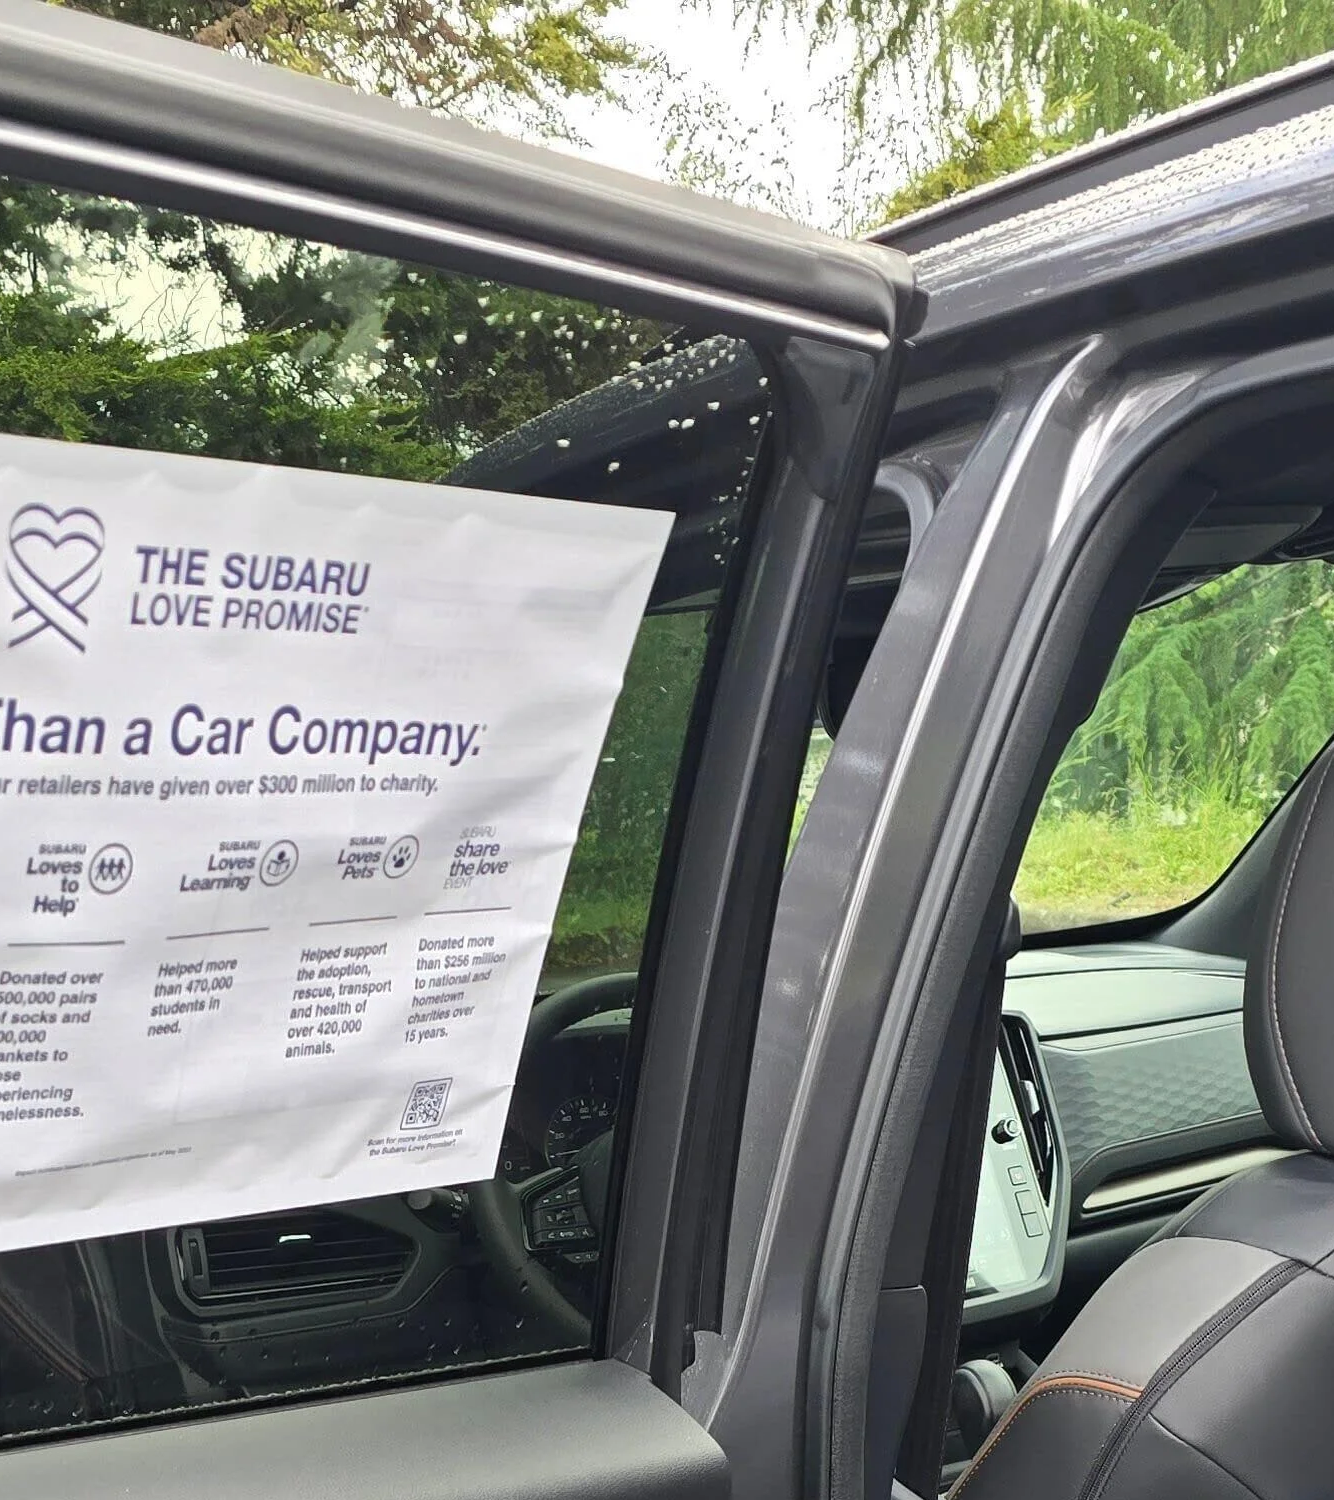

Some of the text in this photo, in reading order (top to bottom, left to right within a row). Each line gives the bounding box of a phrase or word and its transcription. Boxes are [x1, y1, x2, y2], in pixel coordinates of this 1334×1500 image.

[135, 545, 371, 597] THE SUBARU
[130, 592, 360, 634] LOVE PROMISE
[123, 717, 153, 756] a
[171, 703, 254, 756] Car
[268, 704, 479, 765] Company.
[17, 775, 102, 796] retailers
[107, 776, 154, 796] have
[159, 776, 210, 801] given
[215, 779, 254, 795] over
[258, 774, 298, 797] $300
[302, 774, 355, 794] million
[360, 775, 375, 792] to
[380, 773, 438, 797] charity.
[39, 843, 87, 855] SUBARU
[219, 840, 261, 852] SUBARU
[349, 836, 387, 847] SUBARU
[454, 840, 500, 858] share
[207, 854, 256, 872] Loves
[337, 849, 382, 865] Loves
[26, 857, 83, 876] Loves
[342, 865, 375, 880] Pets
[449, 858, 509, 877] the love
[60, 876, 79, 894] to
[180, 873, 251, 892] Learning
[33, 894, 78, 917] Help
[300, 942, 387, 964] Helped support
[419, 936, 494, 952] Donated more
[159, 959, 237, 978] Helped more
[417, 951, 506, 971] than $256 million
[0, 971, 104, 985] Donated over
[297, 963, 371, 981] the adoption,
[415, 969, 492, 990] to national and
[155, 976, 233, 997] than 470,000
[293, 980, 391, 1001] rescue, transport
[60, 991, 97, 1007] pairs
[151, 997, 220, 1017] students in
[412, 991, 464, 1008] hometown
[12, 1011, 57, 1024] socks
[62, 1010, 91, 1024] and
[290, 999, 367, 1019] and health of
[407, 1006, 475, 1025] charities over
[148, 1020, 181, 1036] need.
[288, 1019, 362, 1039] over 420,000
[405, 1028, 448, 1044] 15 years.
[54, 1049, 68, 1061] to
[285, 1041, 335, 1058] animals.
